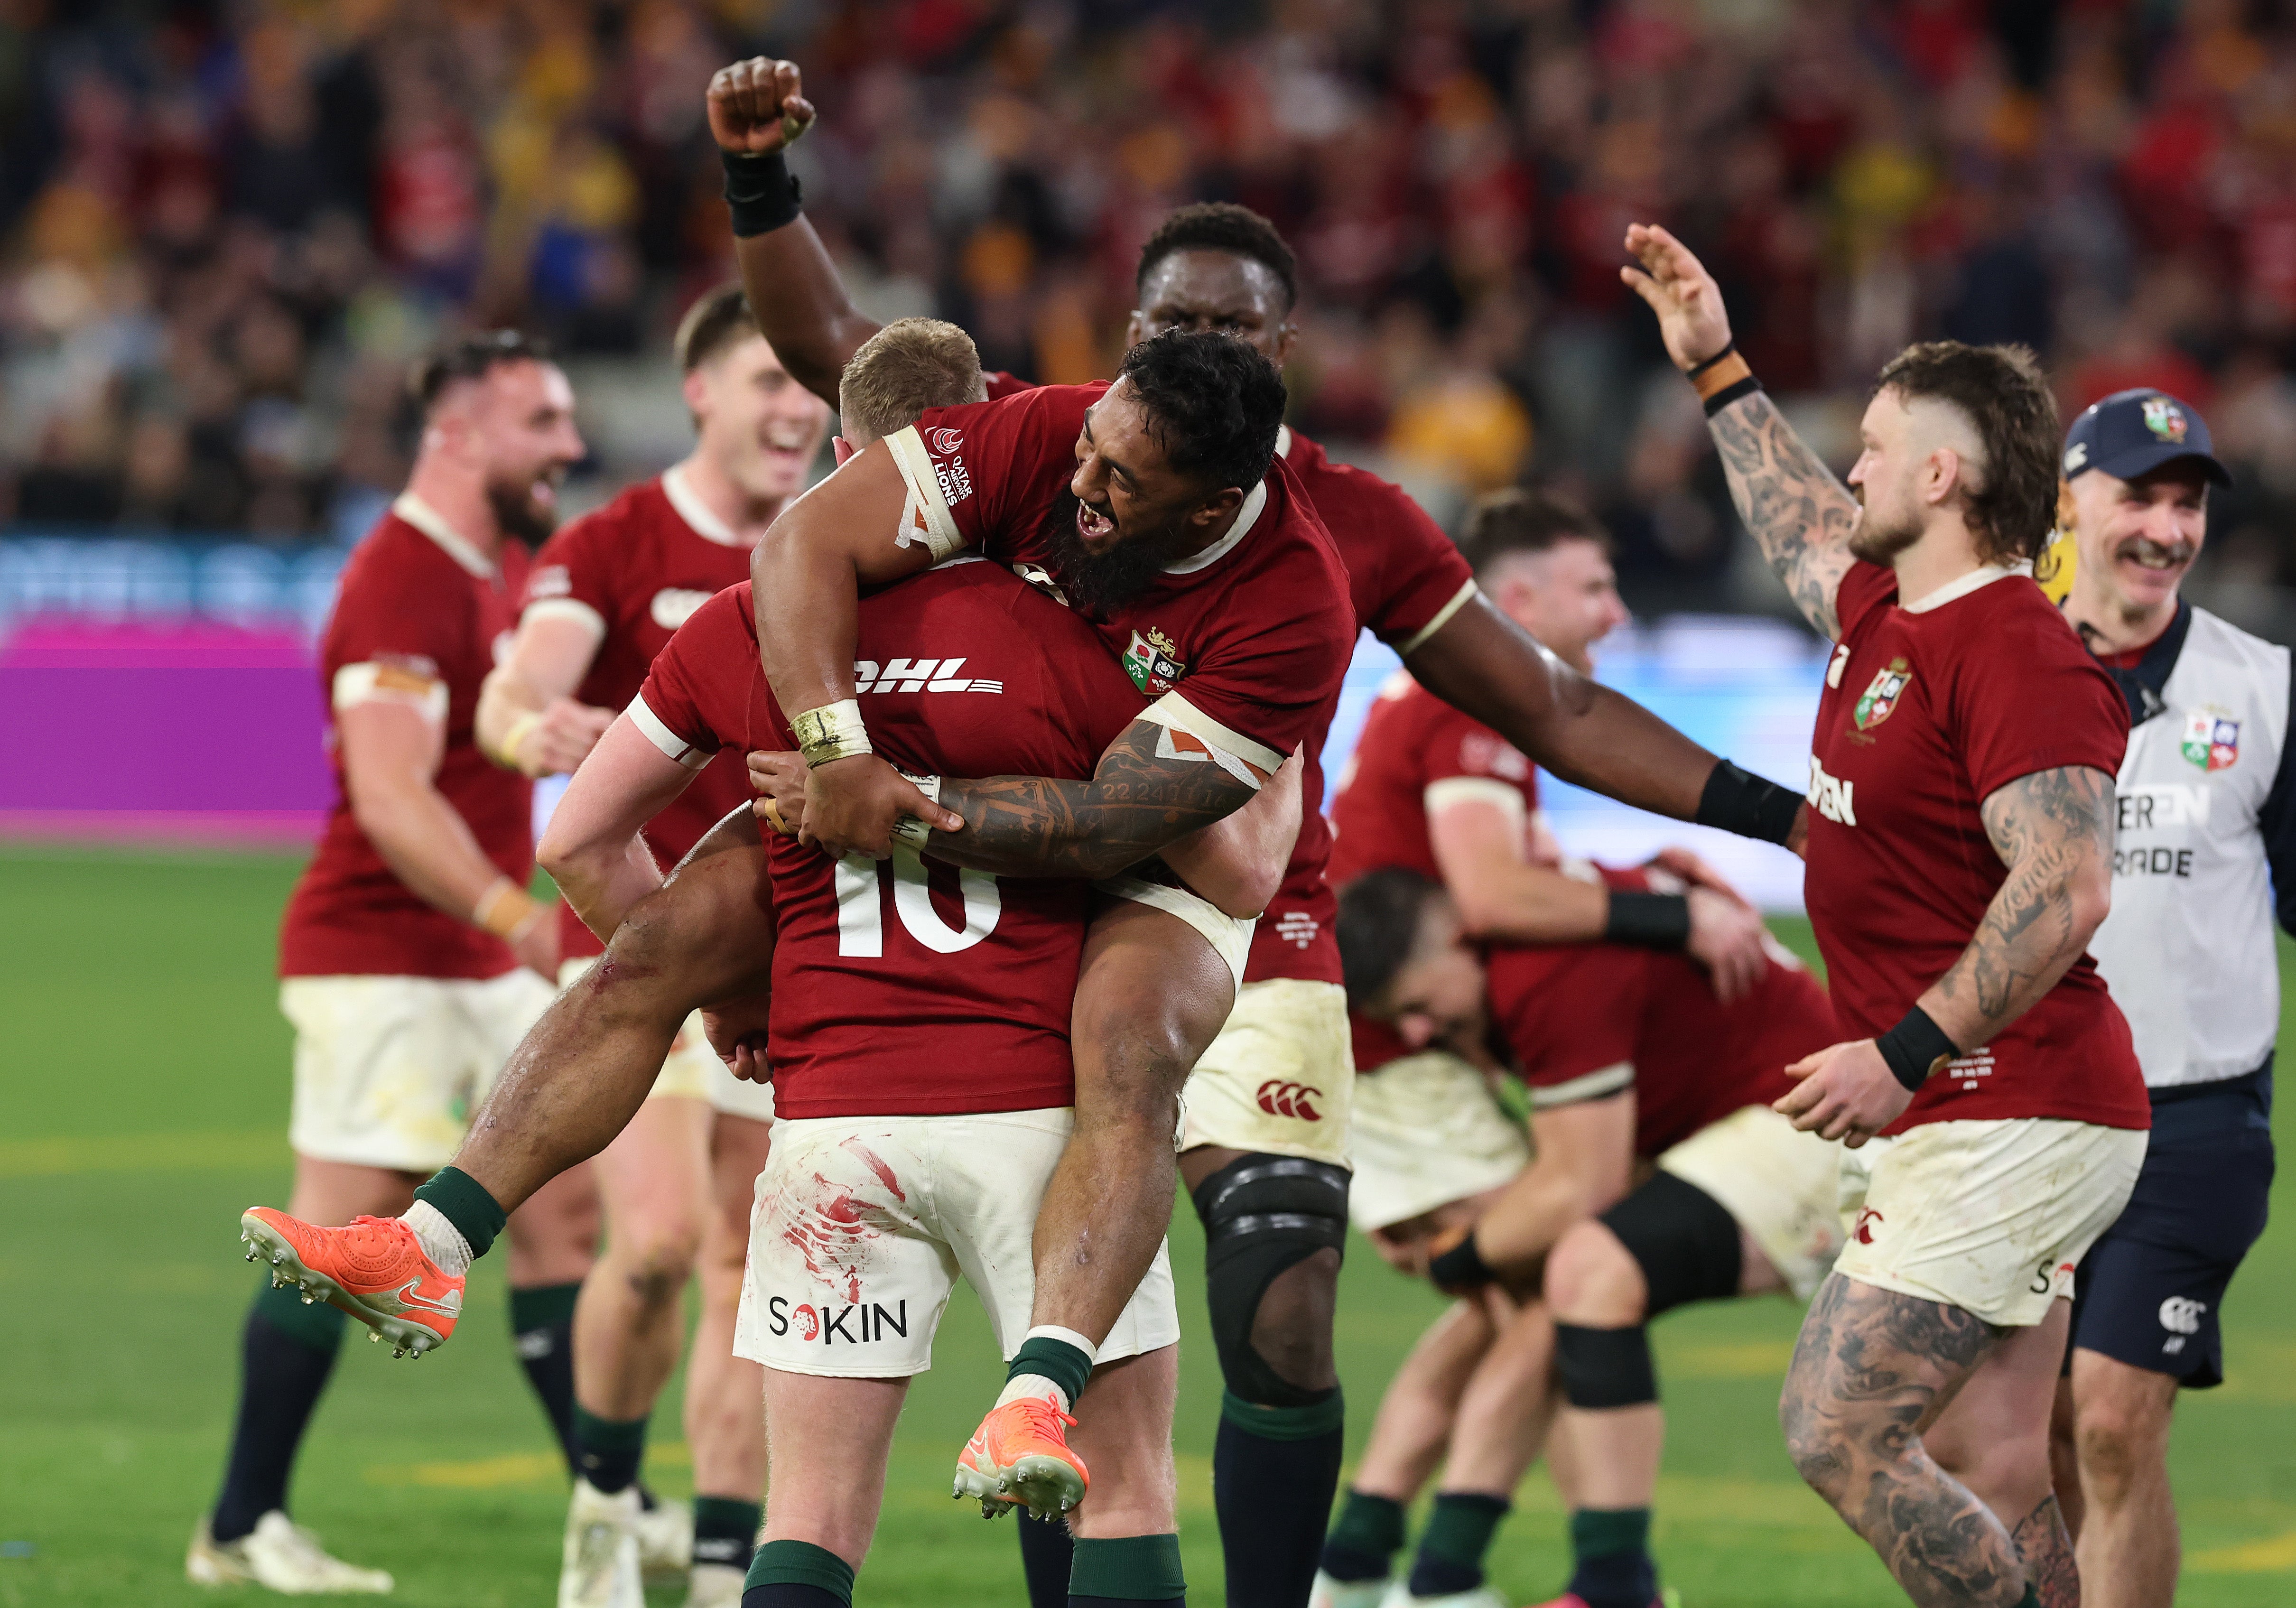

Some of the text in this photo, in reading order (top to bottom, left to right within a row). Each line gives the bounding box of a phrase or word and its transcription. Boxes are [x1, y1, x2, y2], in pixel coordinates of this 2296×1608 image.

[934, 463, 957, 506] LIONS
[950, 469, 967, 501] AIRWAYS
[952, 455, 972, 497] QATAR
[854, 657, 974, 694] DHL
[1102, 783, 1131, 800] 22
[769, 1296, 907, 1345] SOKIN
